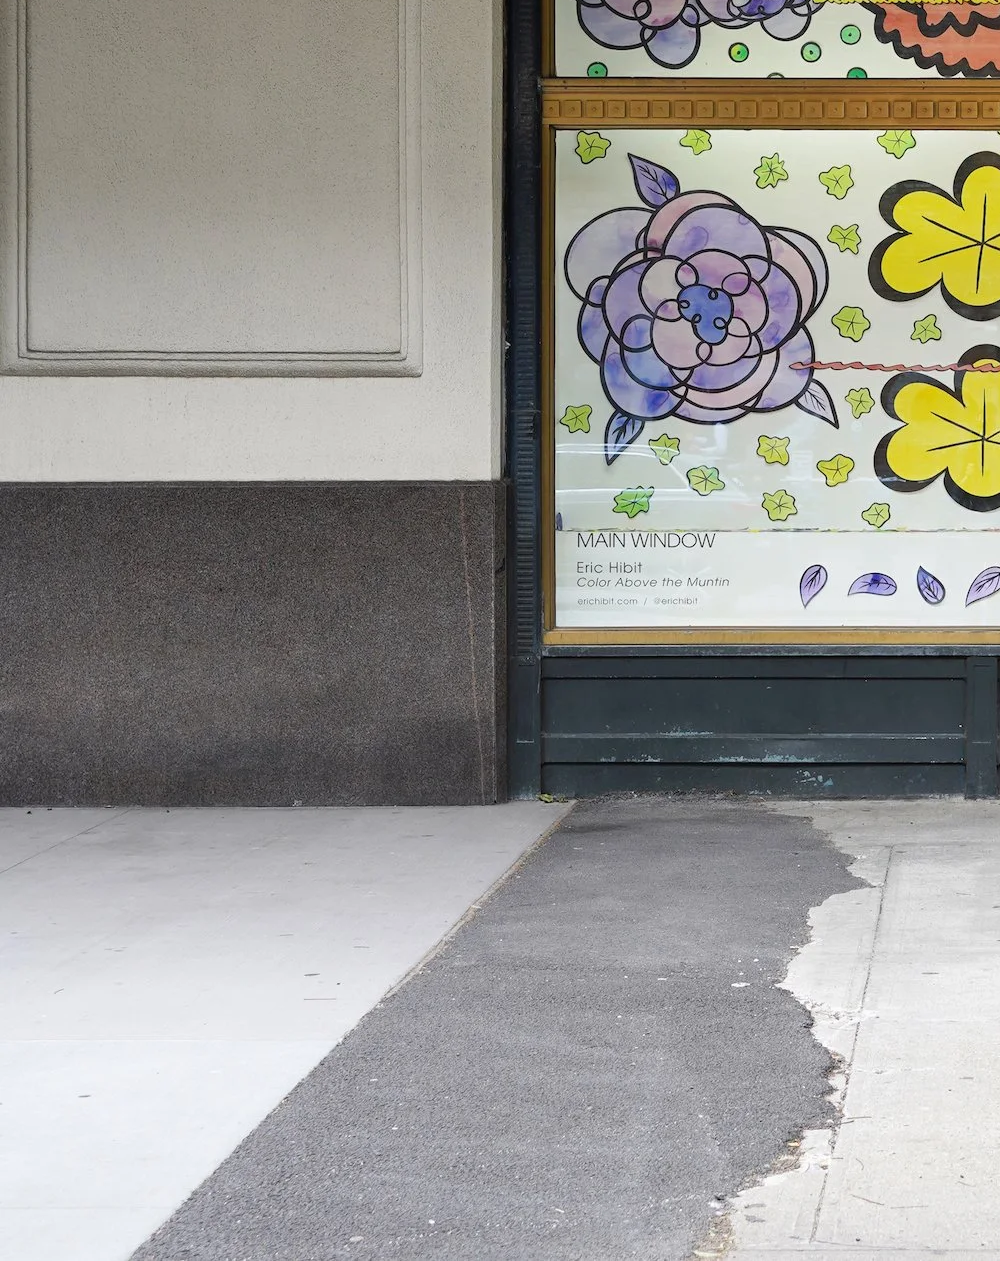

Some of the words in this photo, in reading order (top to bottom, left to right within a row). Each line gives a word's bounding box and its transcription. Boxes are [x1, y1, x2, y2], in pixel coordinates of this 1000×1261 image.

[577, 532, 626, 548] MAIN
[631, 532, 716, 548] WINDOW
[577, 561, 603, 574] Eric
[609, 561, 643, 574] Hibit
[577, 577, 612, 588] Color
[615, 577, 658, 588] Above
[662, 577, 682, 588] the
[686, 577, 730, 588] Muntin
[578, 597, 638, 606] erichibit.com
